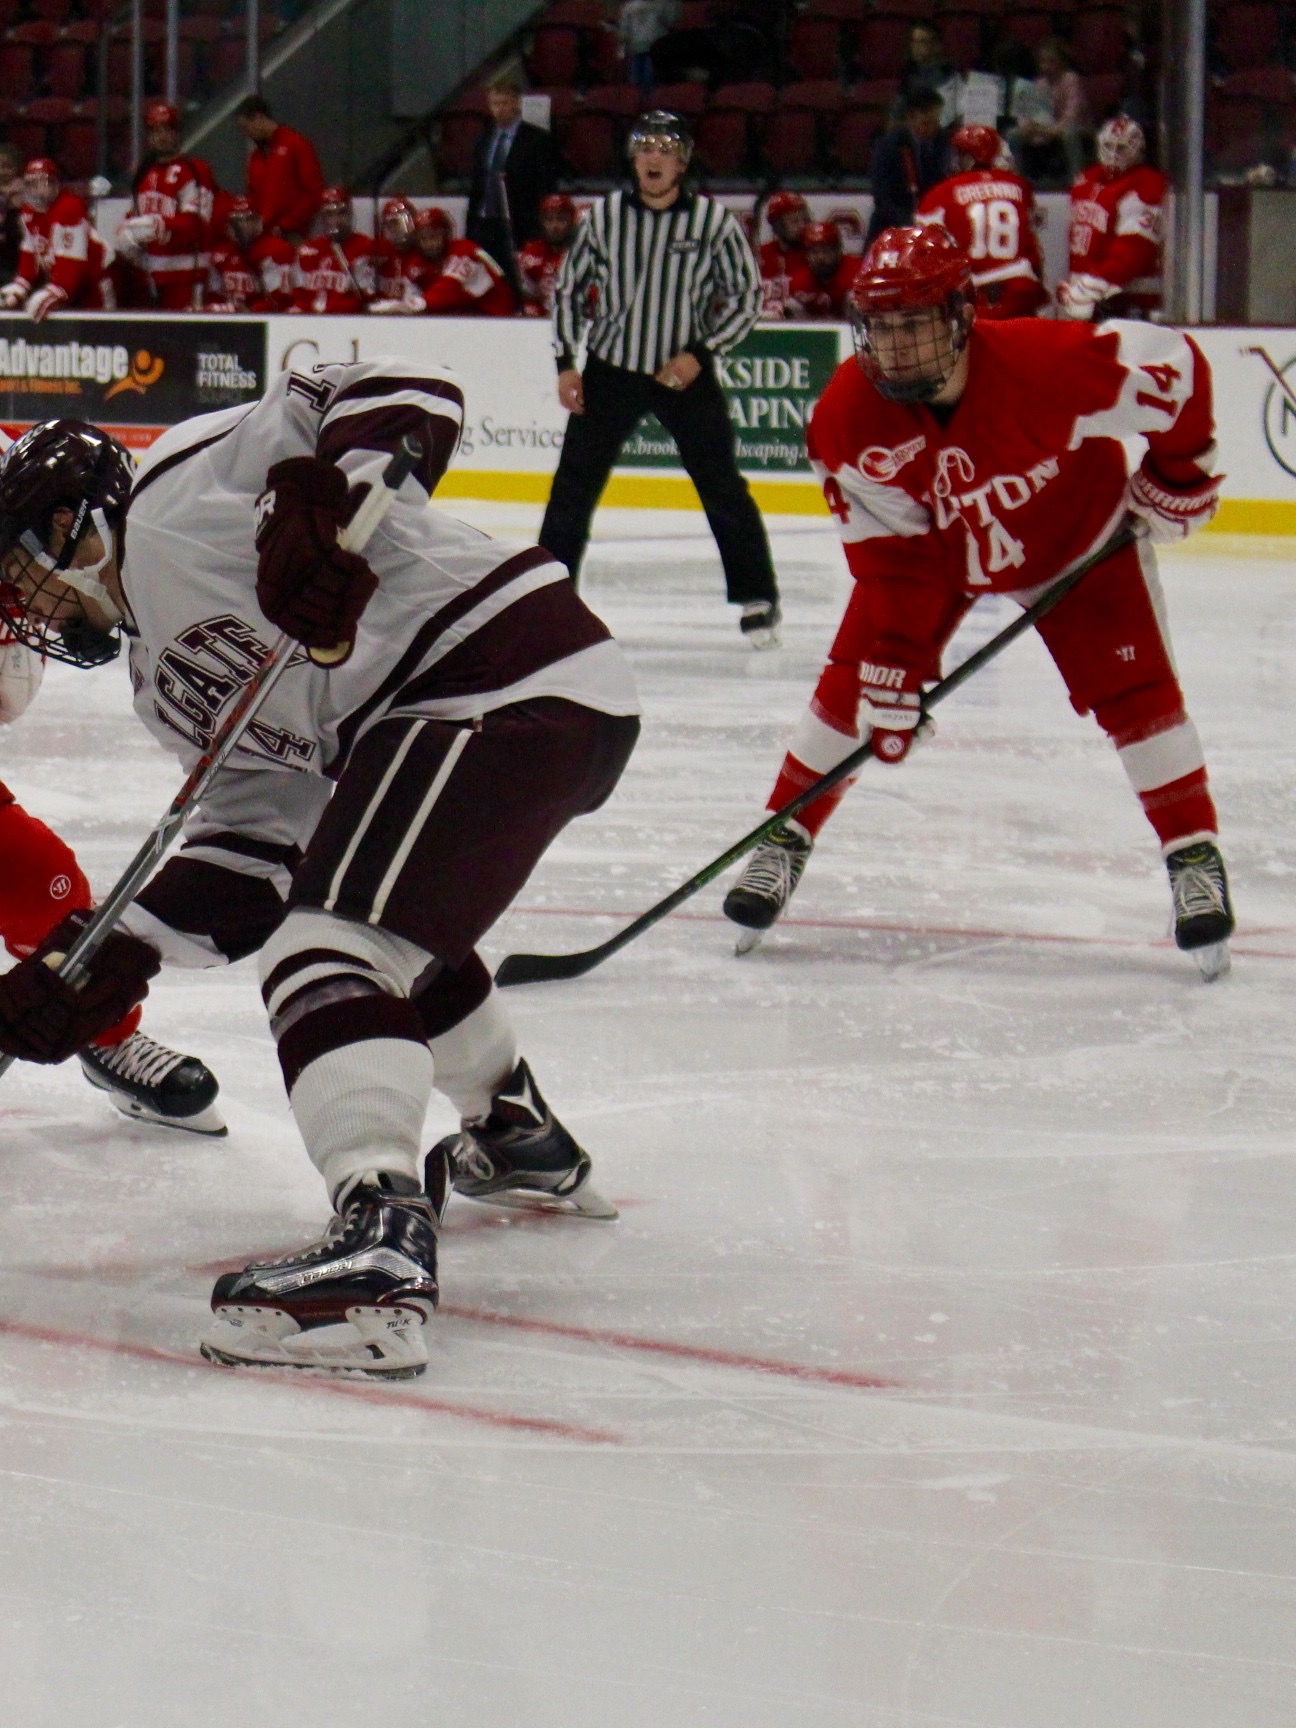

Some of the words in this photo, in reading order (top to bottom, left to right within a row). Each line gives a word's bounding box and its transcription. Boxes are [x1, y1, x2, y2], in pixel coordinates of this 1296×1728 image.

[967, 200, 1020, 260] 18
[197, 352, 243, 371] TOTAL
[197, 371, 257, 389] FITNESS
[1136, 363, 1181, 418] 14
[965, 519, 1026, 586] 14
[386, 1318, 411, 1329] TUK
